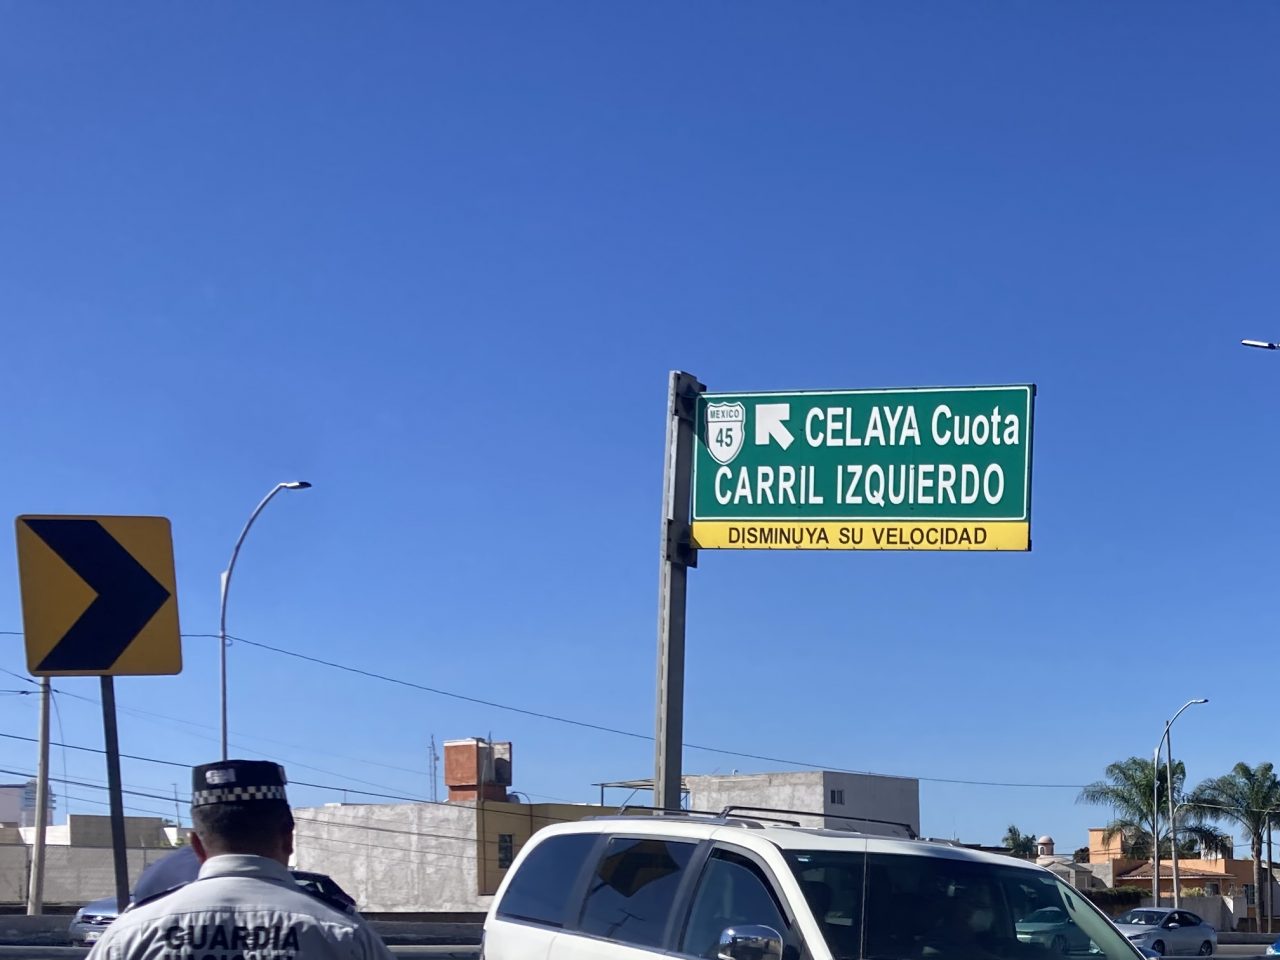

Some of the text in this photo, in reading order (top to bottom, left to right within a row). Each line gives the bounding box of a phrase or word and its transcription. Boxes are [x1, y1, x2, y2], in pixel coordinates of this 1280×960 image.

[710, 409, 740, 419] MEXICO
[805, 404, 1020, 447] CELAYA Cuota
[715, 427, 734, 448] 45
[714, 463, 1005, 508] CARRIL IZQUIERDO
[728, 526, 988, 545] DISMINUYA SU VELOCIDAD
[165, 925, 300, 951] GUARDIA
